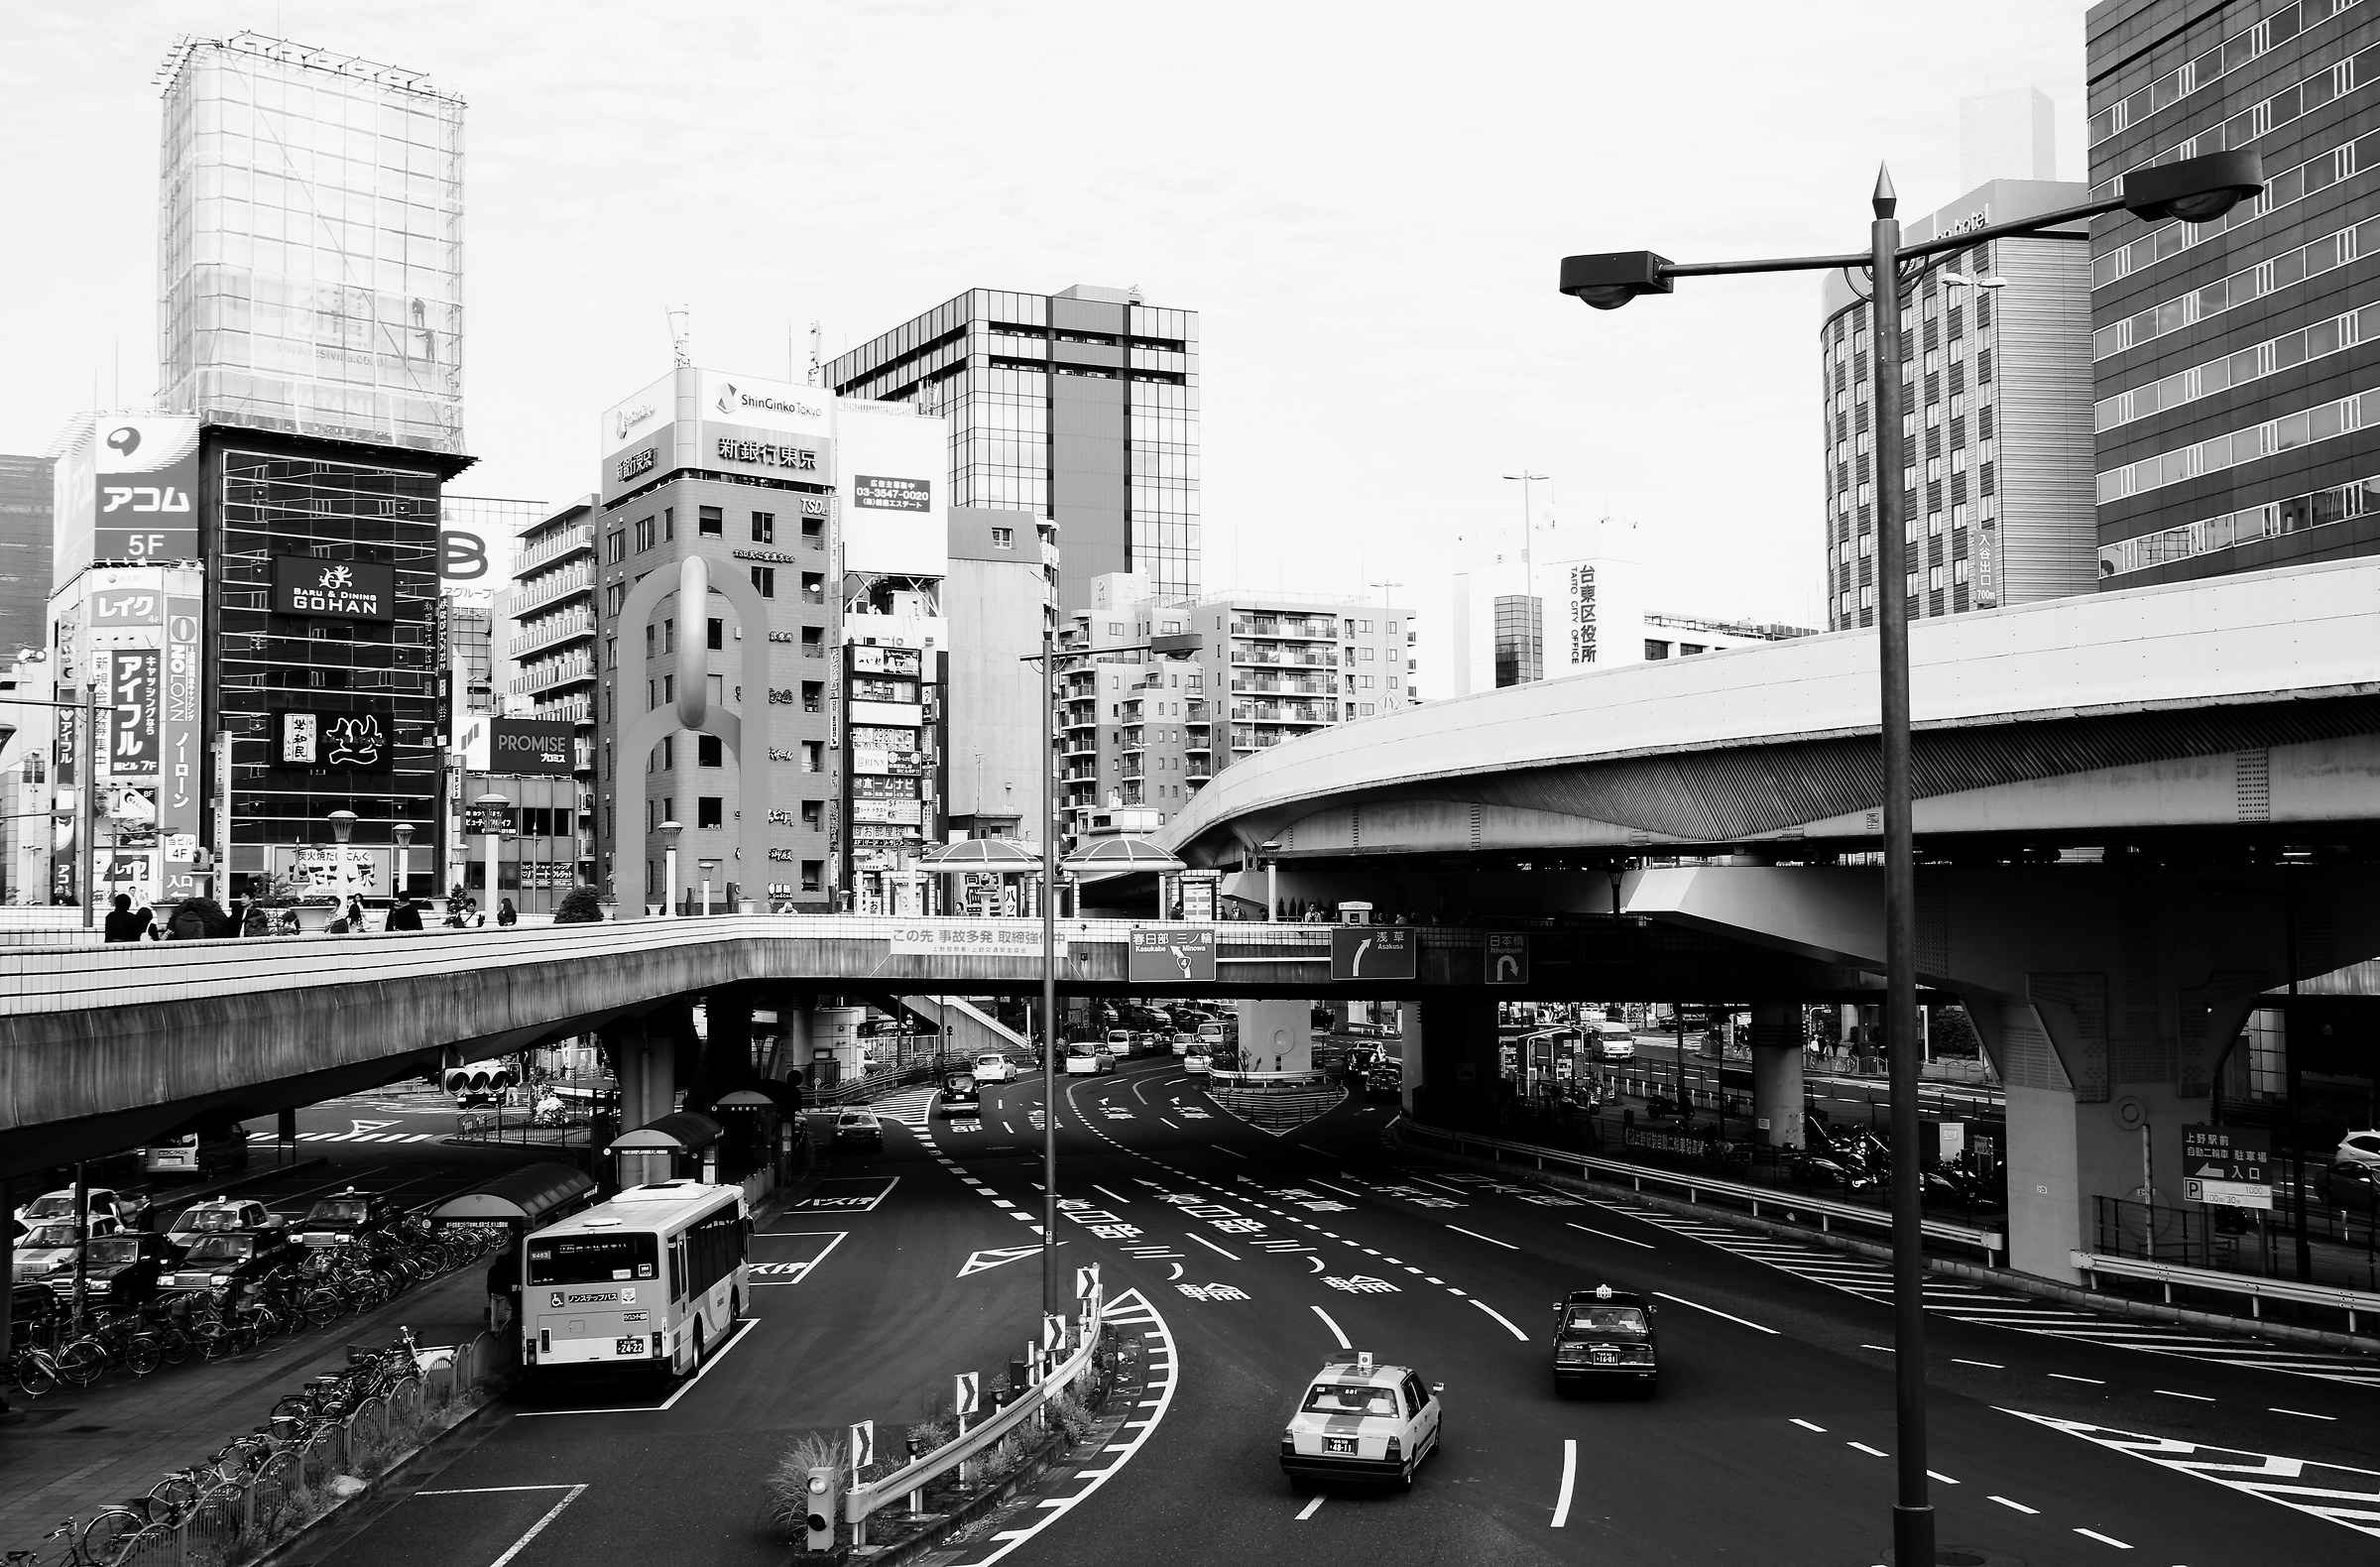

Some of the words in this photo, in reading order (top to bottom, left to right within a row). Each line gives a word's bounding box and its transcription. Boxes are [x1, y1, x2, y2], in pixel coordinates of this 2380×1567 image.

[1955, 202, 1989, 235] hotel
[742, 395, 794, 413] ShinGinko
[796, 403, 822, 418] Tokyo
[719, 437, 817, 469] 新銀行東京
[617, 447, 655, 482] 新銀行東京
[103, 487, 190, 513] アコム
[856, 487, 929, 501] 03-3547-0020
[129, 535, 165, 555] 5F
[1978, 534, 1991, 586] 入谷出口
[294, 587, 322, 596] BARU
[340, 591, 377, 601] DINING
[1976, 589, 1995, 600] 700m
[99, 596, 155, 617] レイク
[294, 595, 377, 615] GOHAN
[1580, 564, 1596, 663] 台東区役所
[171, 645, 184, 722] NOLOAN
[145, 657, 156, 736] キャッシングなら
[117, 657, 143, 756] アイフル
[60, 721, 73, 764] アイフル
[498, 734, 566, 753] PROMISE
[141, 760, 157, 771] 7F
[540, 753, 566, 763] プロミス
[174, 732, 189, 809] ノーローン
[864, 778, 914, 790] ホームナビ
[173, 849, 187, 859] 4F
[167, 875, 193, 888] 入口
[893, 929, 934, 942] この先
[938, 929, 994, 943] 事故多発
[1132, 932, 1169, 945] 春日部
[1176, 932, 1213, 945] 三ノ輪
[1376, 930, 1405, 942] 浅草
[1490, 935, 1524, 946] 日本橋
[1180, 958, 1187, 967] 4
[2186, 1132, 2229, 1146] 上野駅前
[2187, 1146, 2229, 1159] 自動二輪車
[2234, 1149, 2268, 1163] 駐車場
[2231, 1164, 2260, 1181] 入口
[2189, 1181, 2199, 1197] P
[569, 1293, 618, 1302] ノンステップバス
